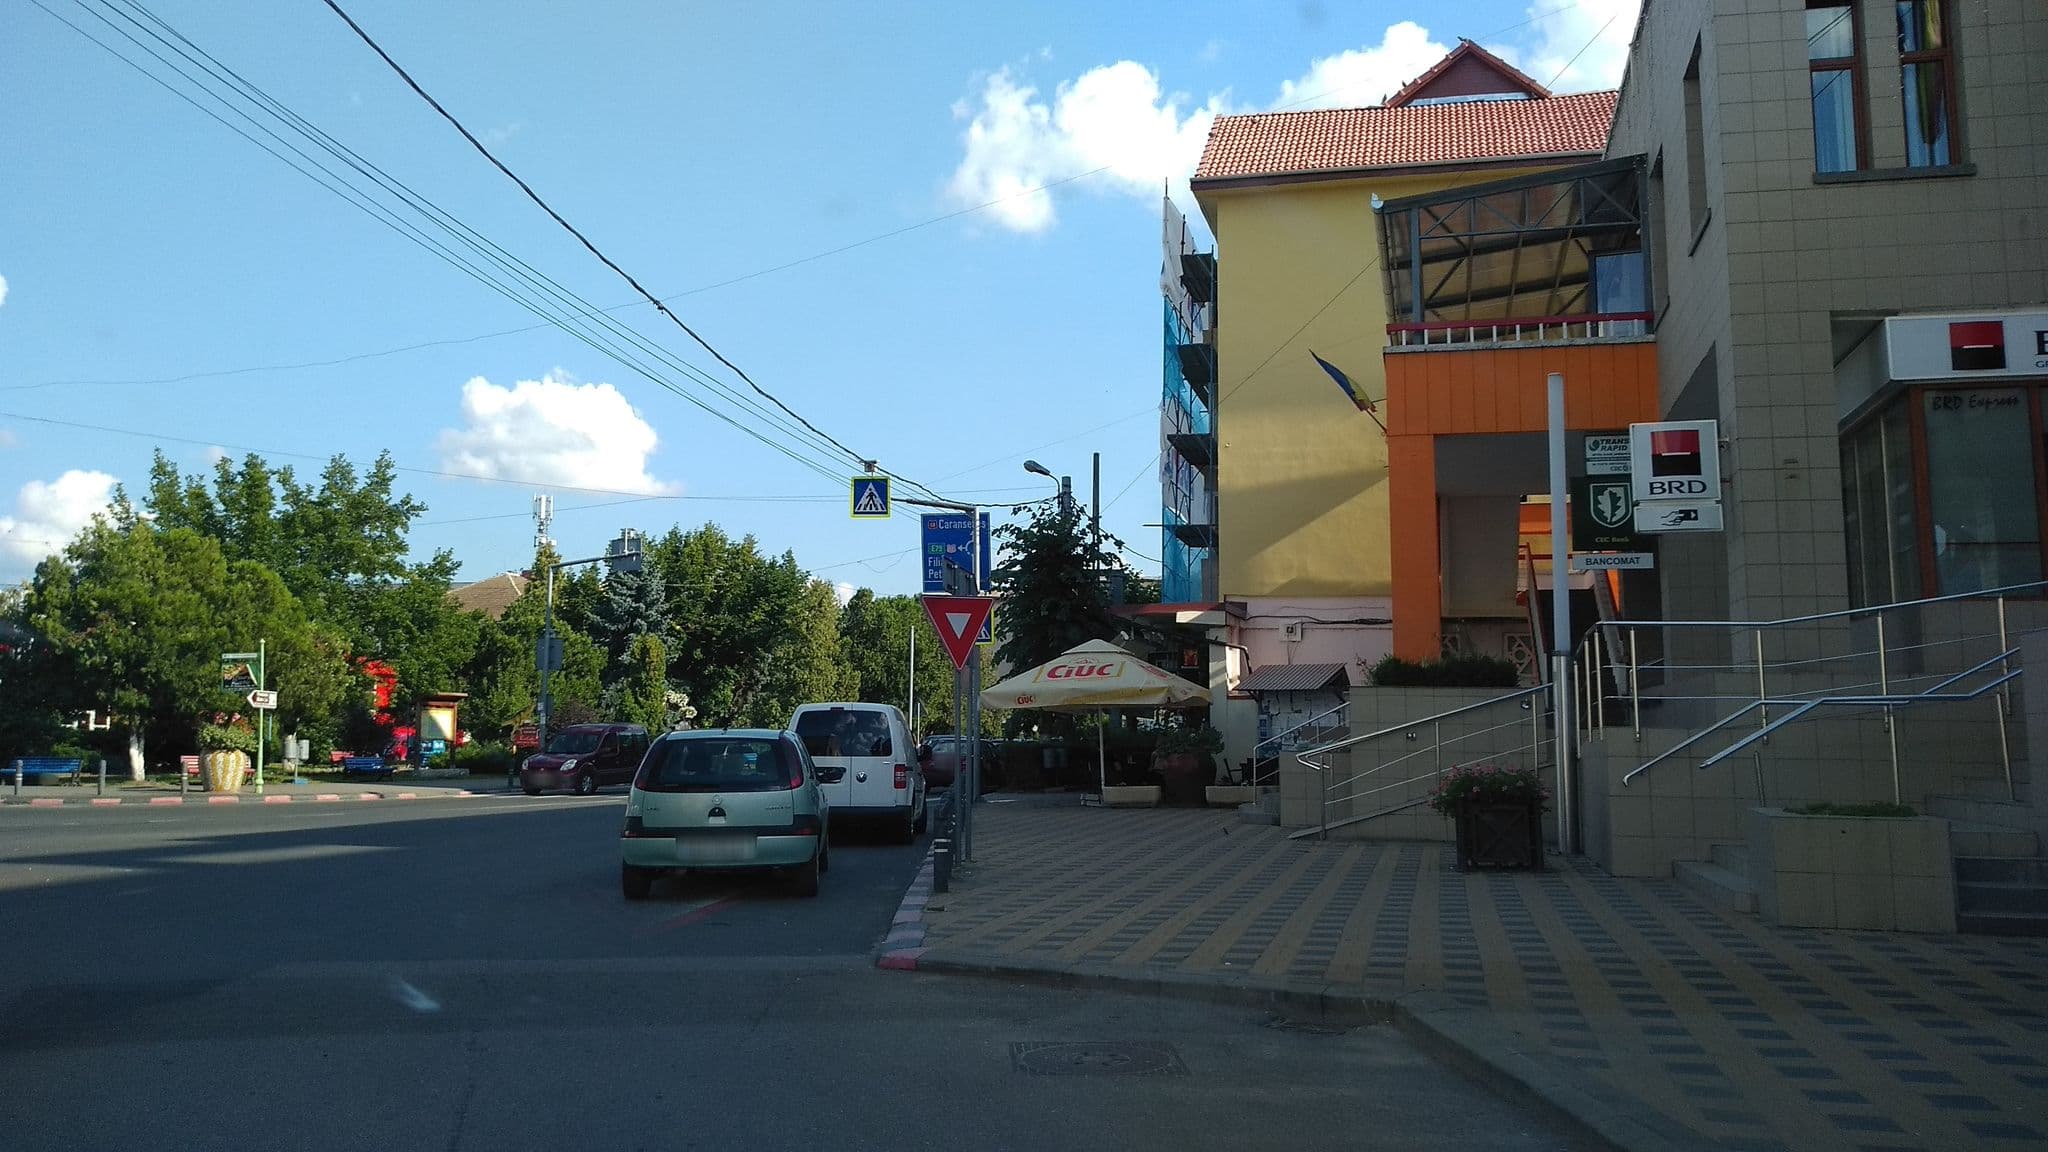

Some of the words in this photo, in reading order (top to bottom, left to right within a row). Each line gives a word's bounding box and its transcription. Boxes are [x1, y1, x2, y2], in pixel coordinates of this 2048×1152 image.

[1648, 480, 1707, 495] BRD
[938, 519, 986, 529] Caranses
[1586, 557, 1640, 566] BANCOMAT
